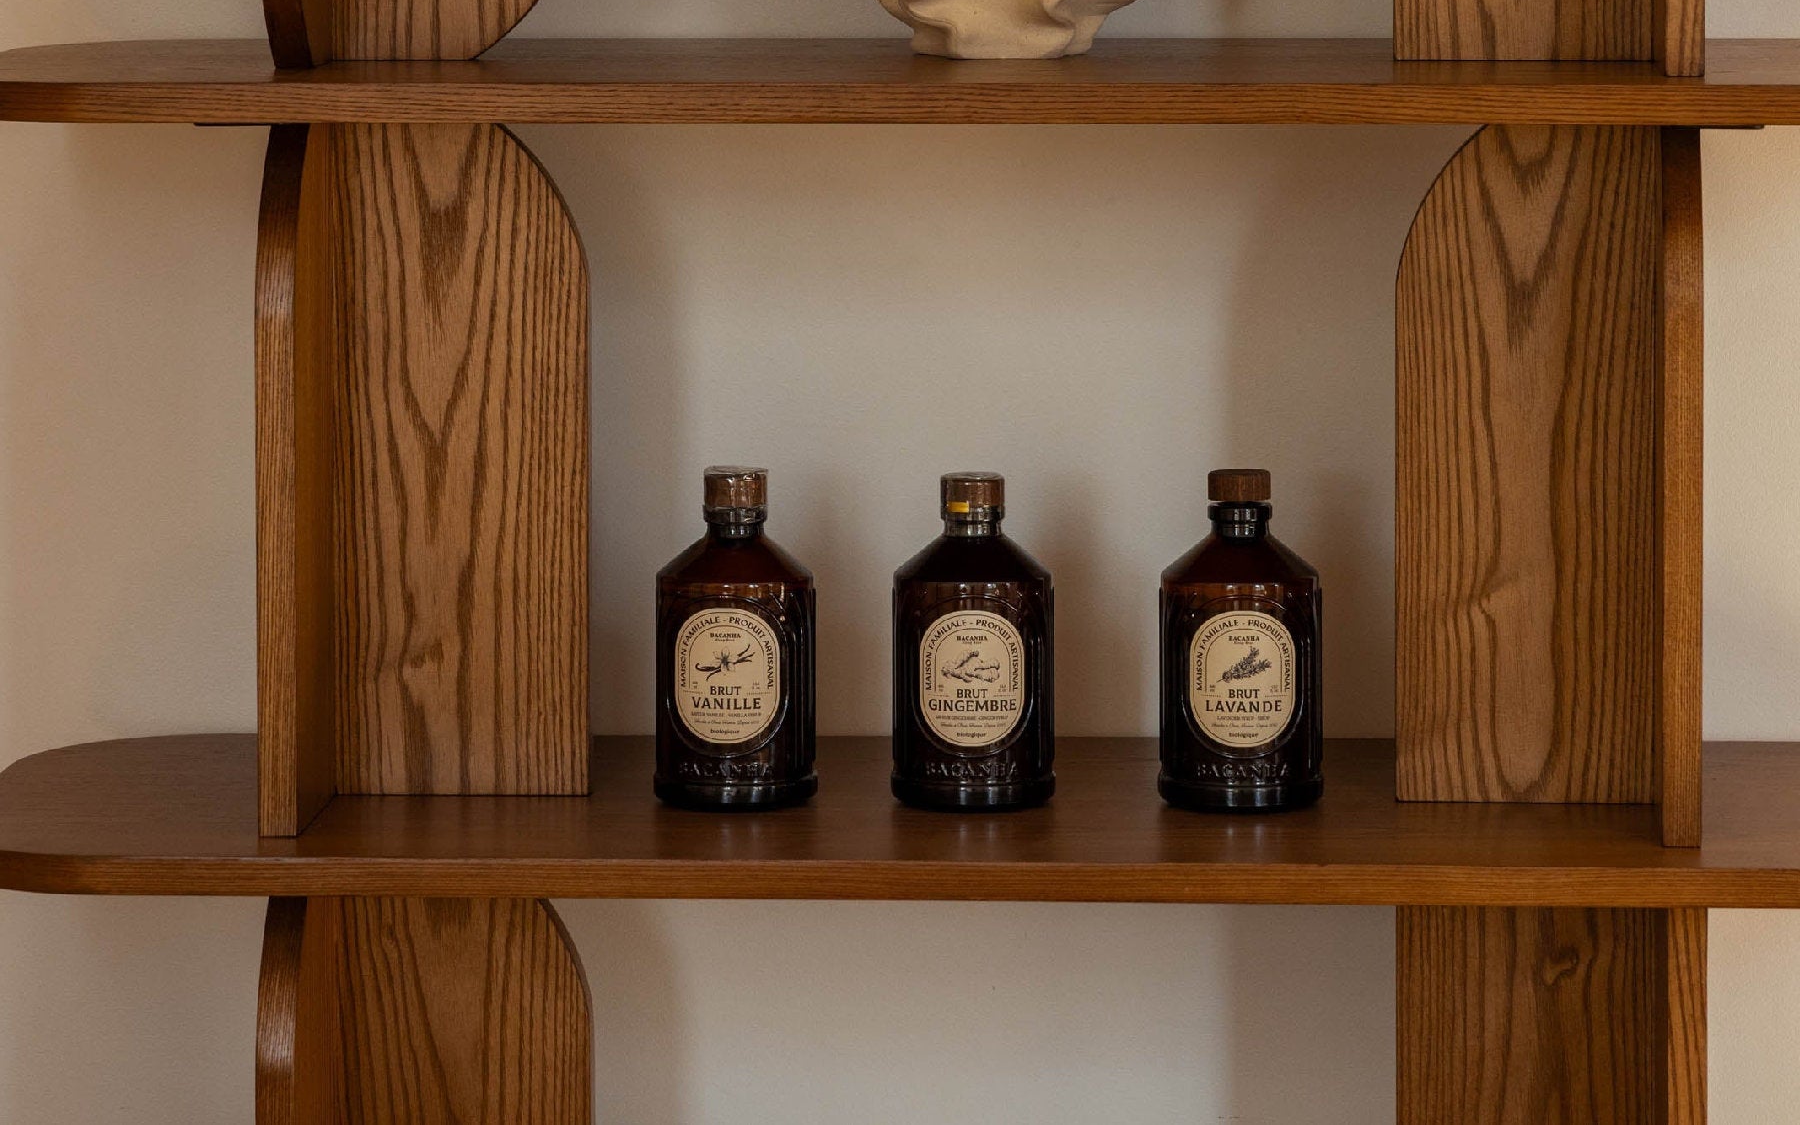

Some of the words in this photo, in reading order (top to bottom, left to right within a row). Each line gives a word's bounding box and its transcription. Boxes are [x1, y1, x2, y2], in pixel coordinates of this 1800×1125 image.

[683, 616, 721, 647] FAMILIALE
[729, 616, 766, 639] PRODUIT
[1199, 619, 1239, 650] FAMILIALE
[1247, 619, 1284, 642] PRODUIT
[763, 640, 775, 690] ARTISANAL
[930, 619, 967, 650] FAMILIALE
[975, 619, 1012, 642] PRODUIT
[1008, 642, 1019, 692] ARTISANAL
[1279, 642, 1291, 692] ARTISANAL
[679, 651, 688, 688] MAISON
[1196, 652, 1204, 691] MAISON
[710, 686, 742, 696] BRUT
[956, 688, 988, 699] BRUT
[1228, 688, 1260, 699] BRUT
[692, 696, 762, 710] VANILLE
[928, 699, 1017, 712] GINGEMBRE
[1205, 699, 1282, 713] LAVANDE
